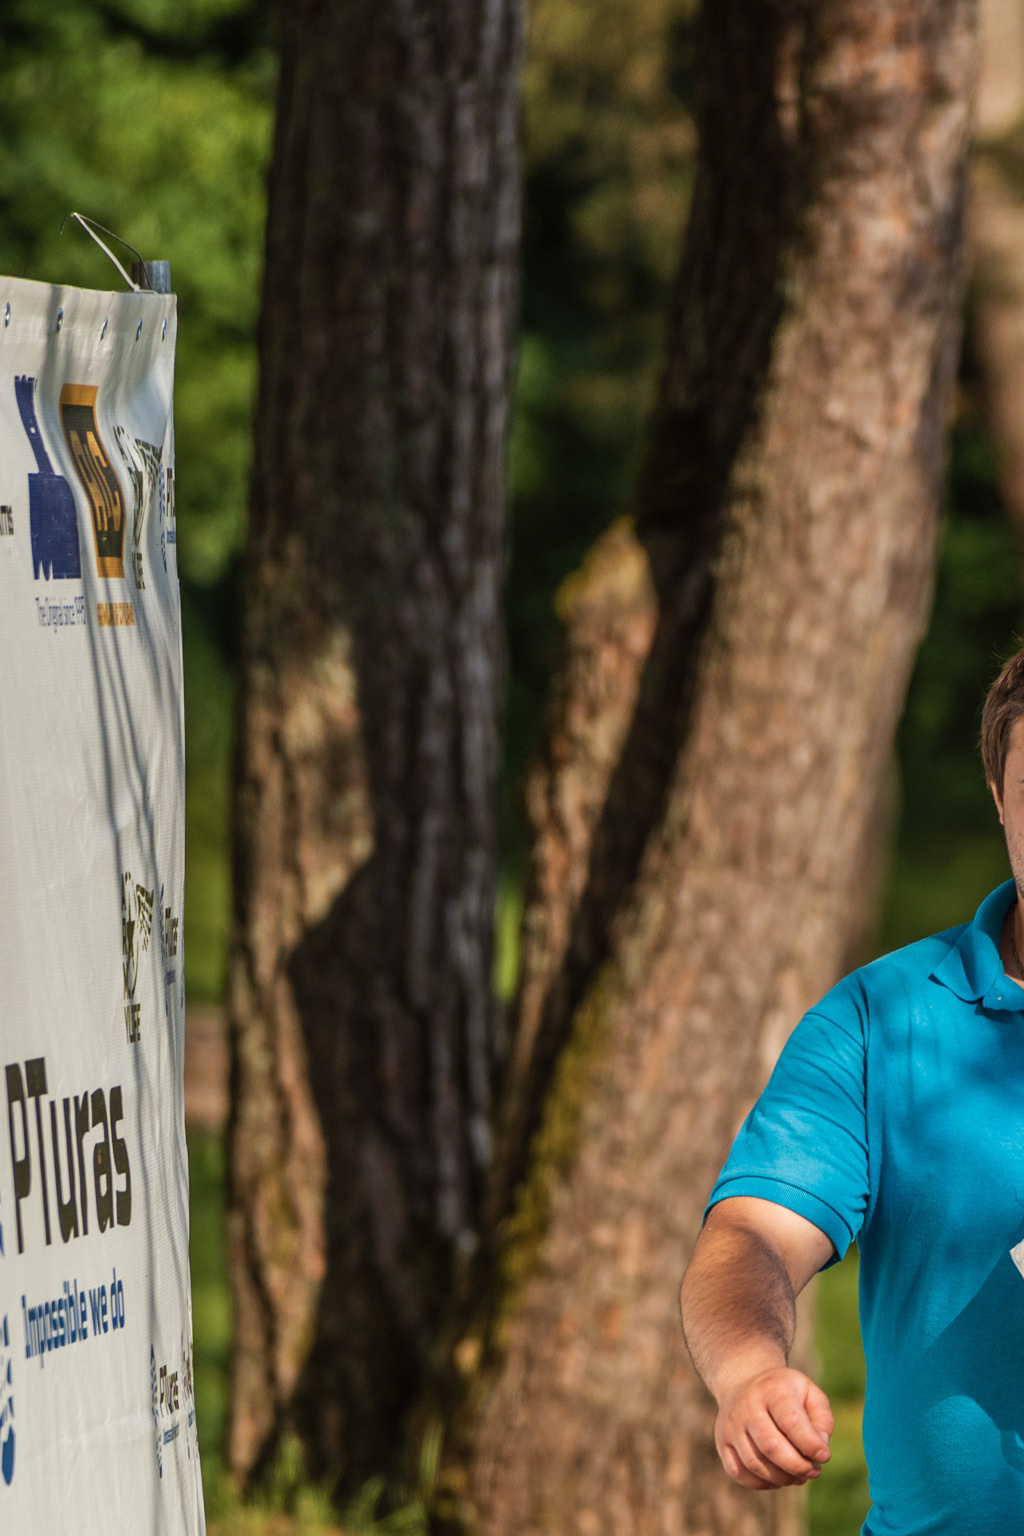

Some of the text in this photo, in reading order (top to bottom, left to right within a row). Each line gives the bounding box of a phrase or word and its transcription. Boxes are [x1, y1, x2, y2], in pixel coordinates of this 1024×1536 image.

[35, 597, 46, 626] The
[45, 597, 63, 633] Original
[5, 1057, 131, 1254] PTuras
[22, 1267, 125, 1369] Impossible we do
